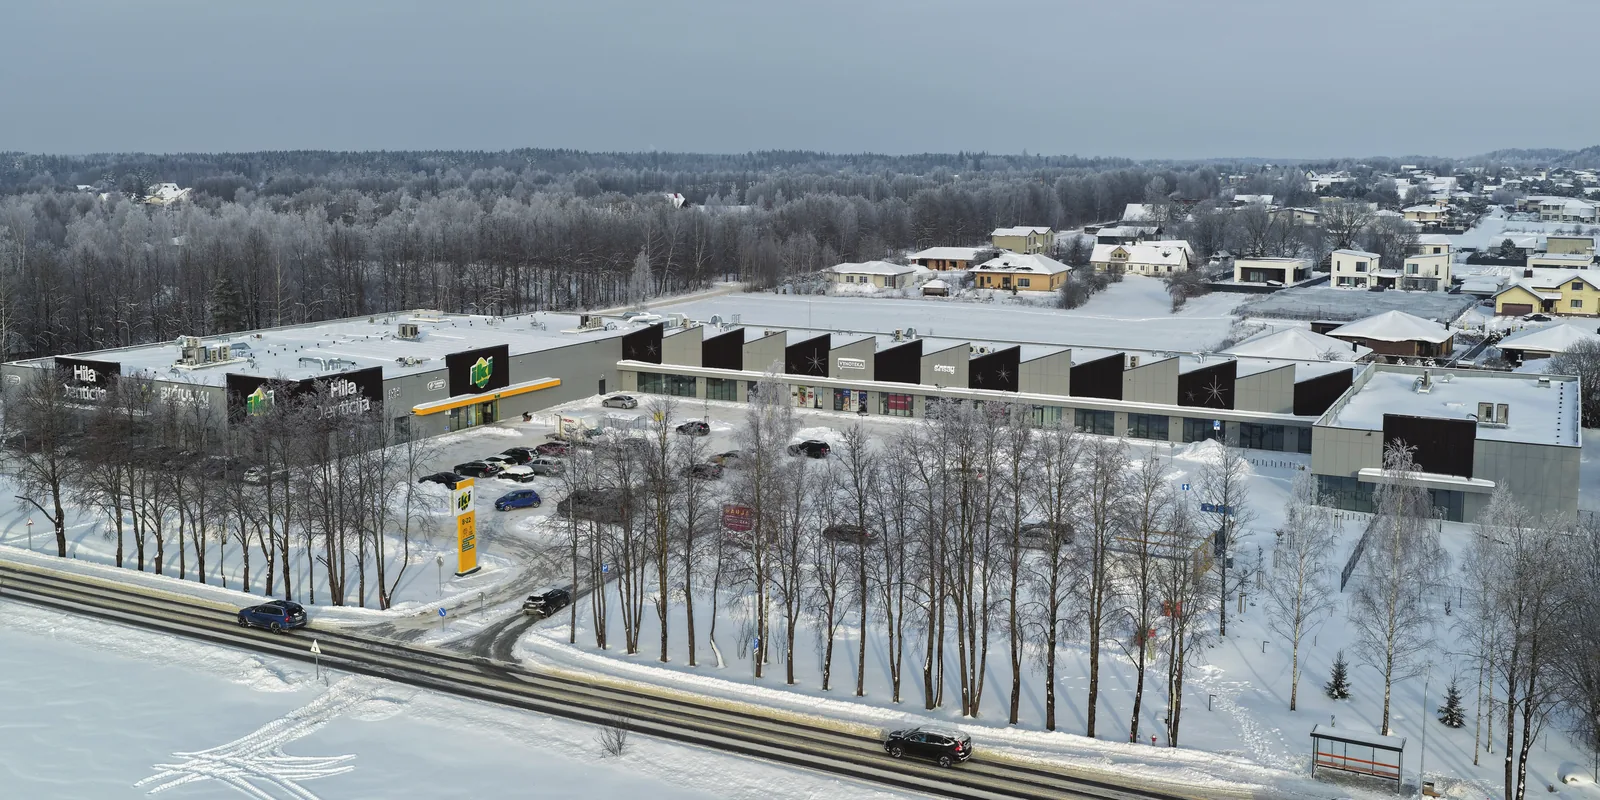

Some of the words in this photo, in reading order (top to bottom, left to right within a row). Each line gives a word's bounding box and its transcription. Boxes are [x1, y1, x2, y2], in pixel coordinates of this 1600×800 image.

[73, 364, 97, 382] Hila
[469, 357, 494, 389] iki
[330, 379, 357, 398] Hila
[457, 490, 472, 511] iki
